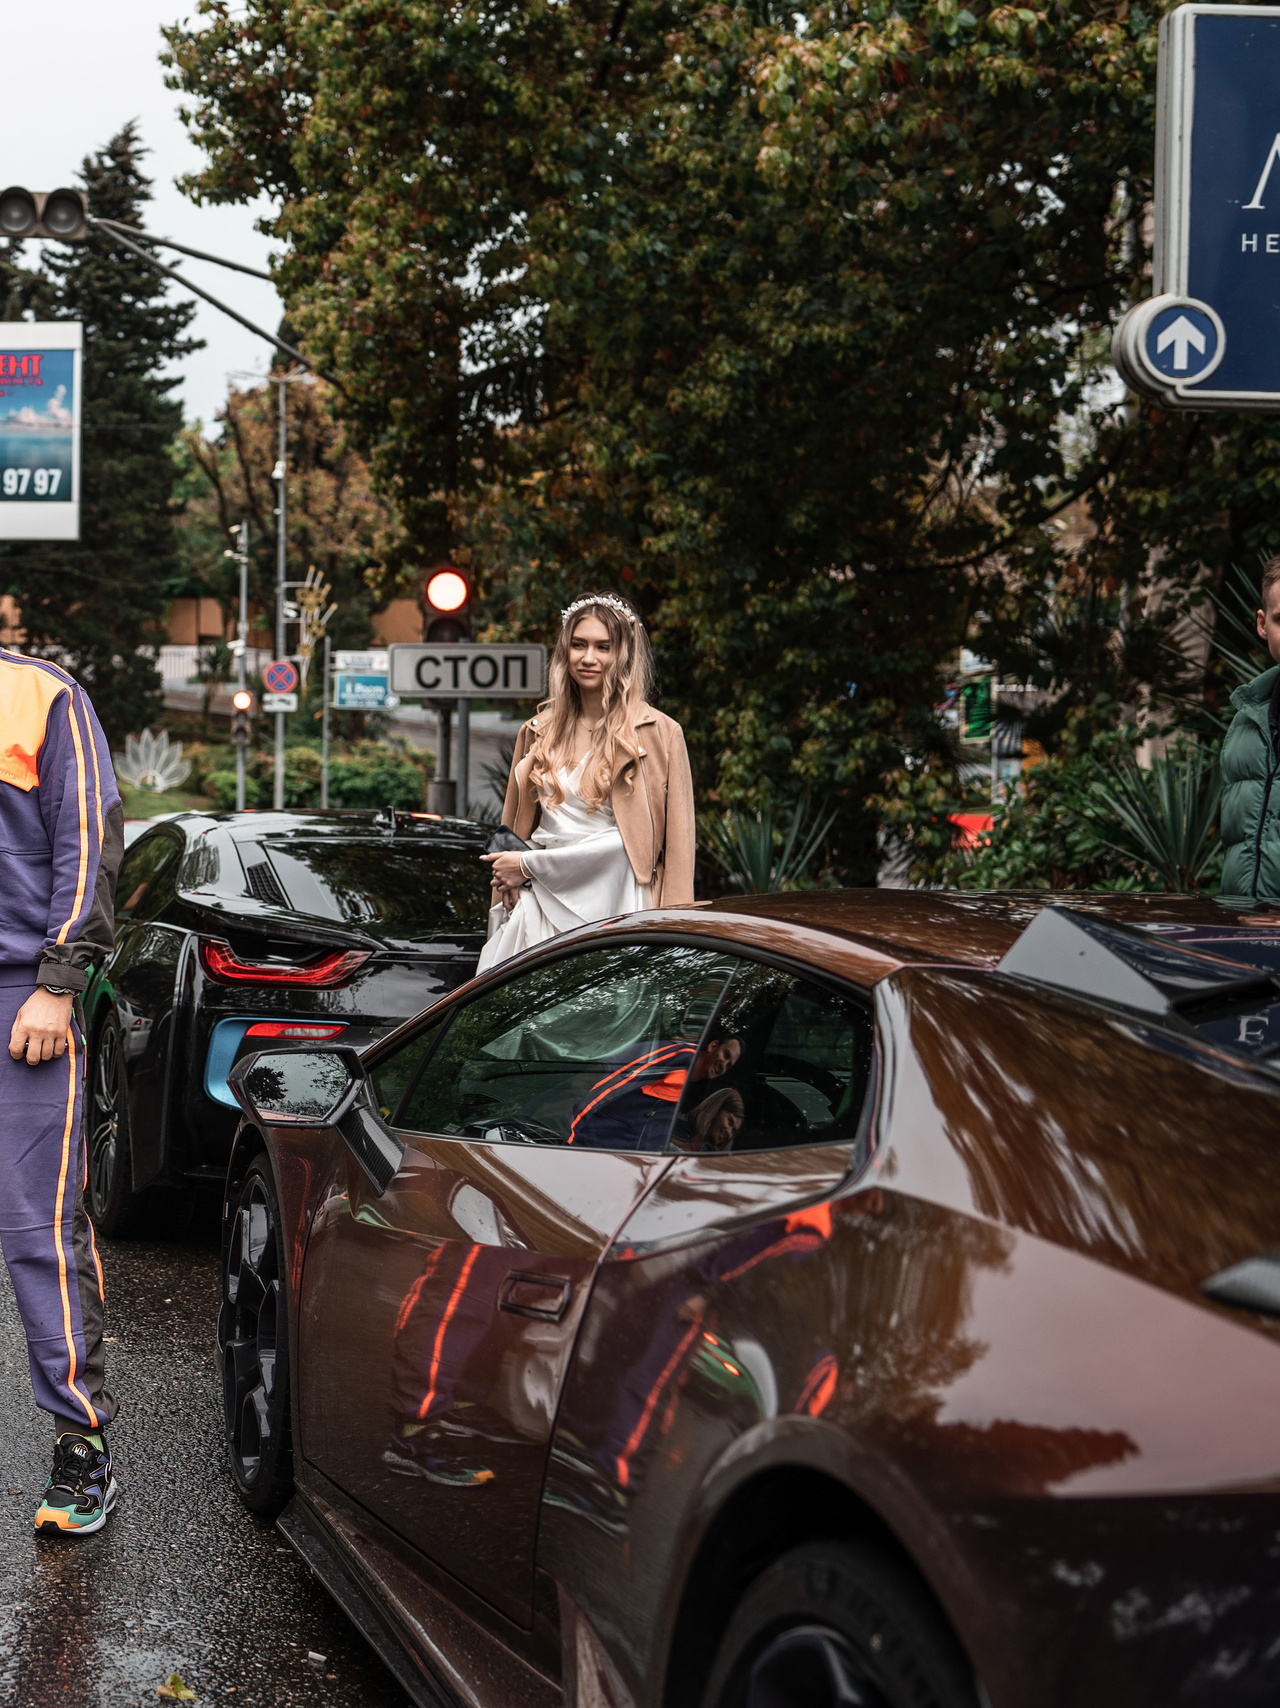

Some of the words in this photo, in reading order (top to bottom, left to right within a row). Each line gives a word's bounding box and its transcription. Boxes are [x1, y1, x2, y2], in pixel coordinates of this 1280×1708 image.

[3, 468, 31, 495] 97
[34, 468, 62, 495] 97
[415, 655, 527, 689] СТОП
